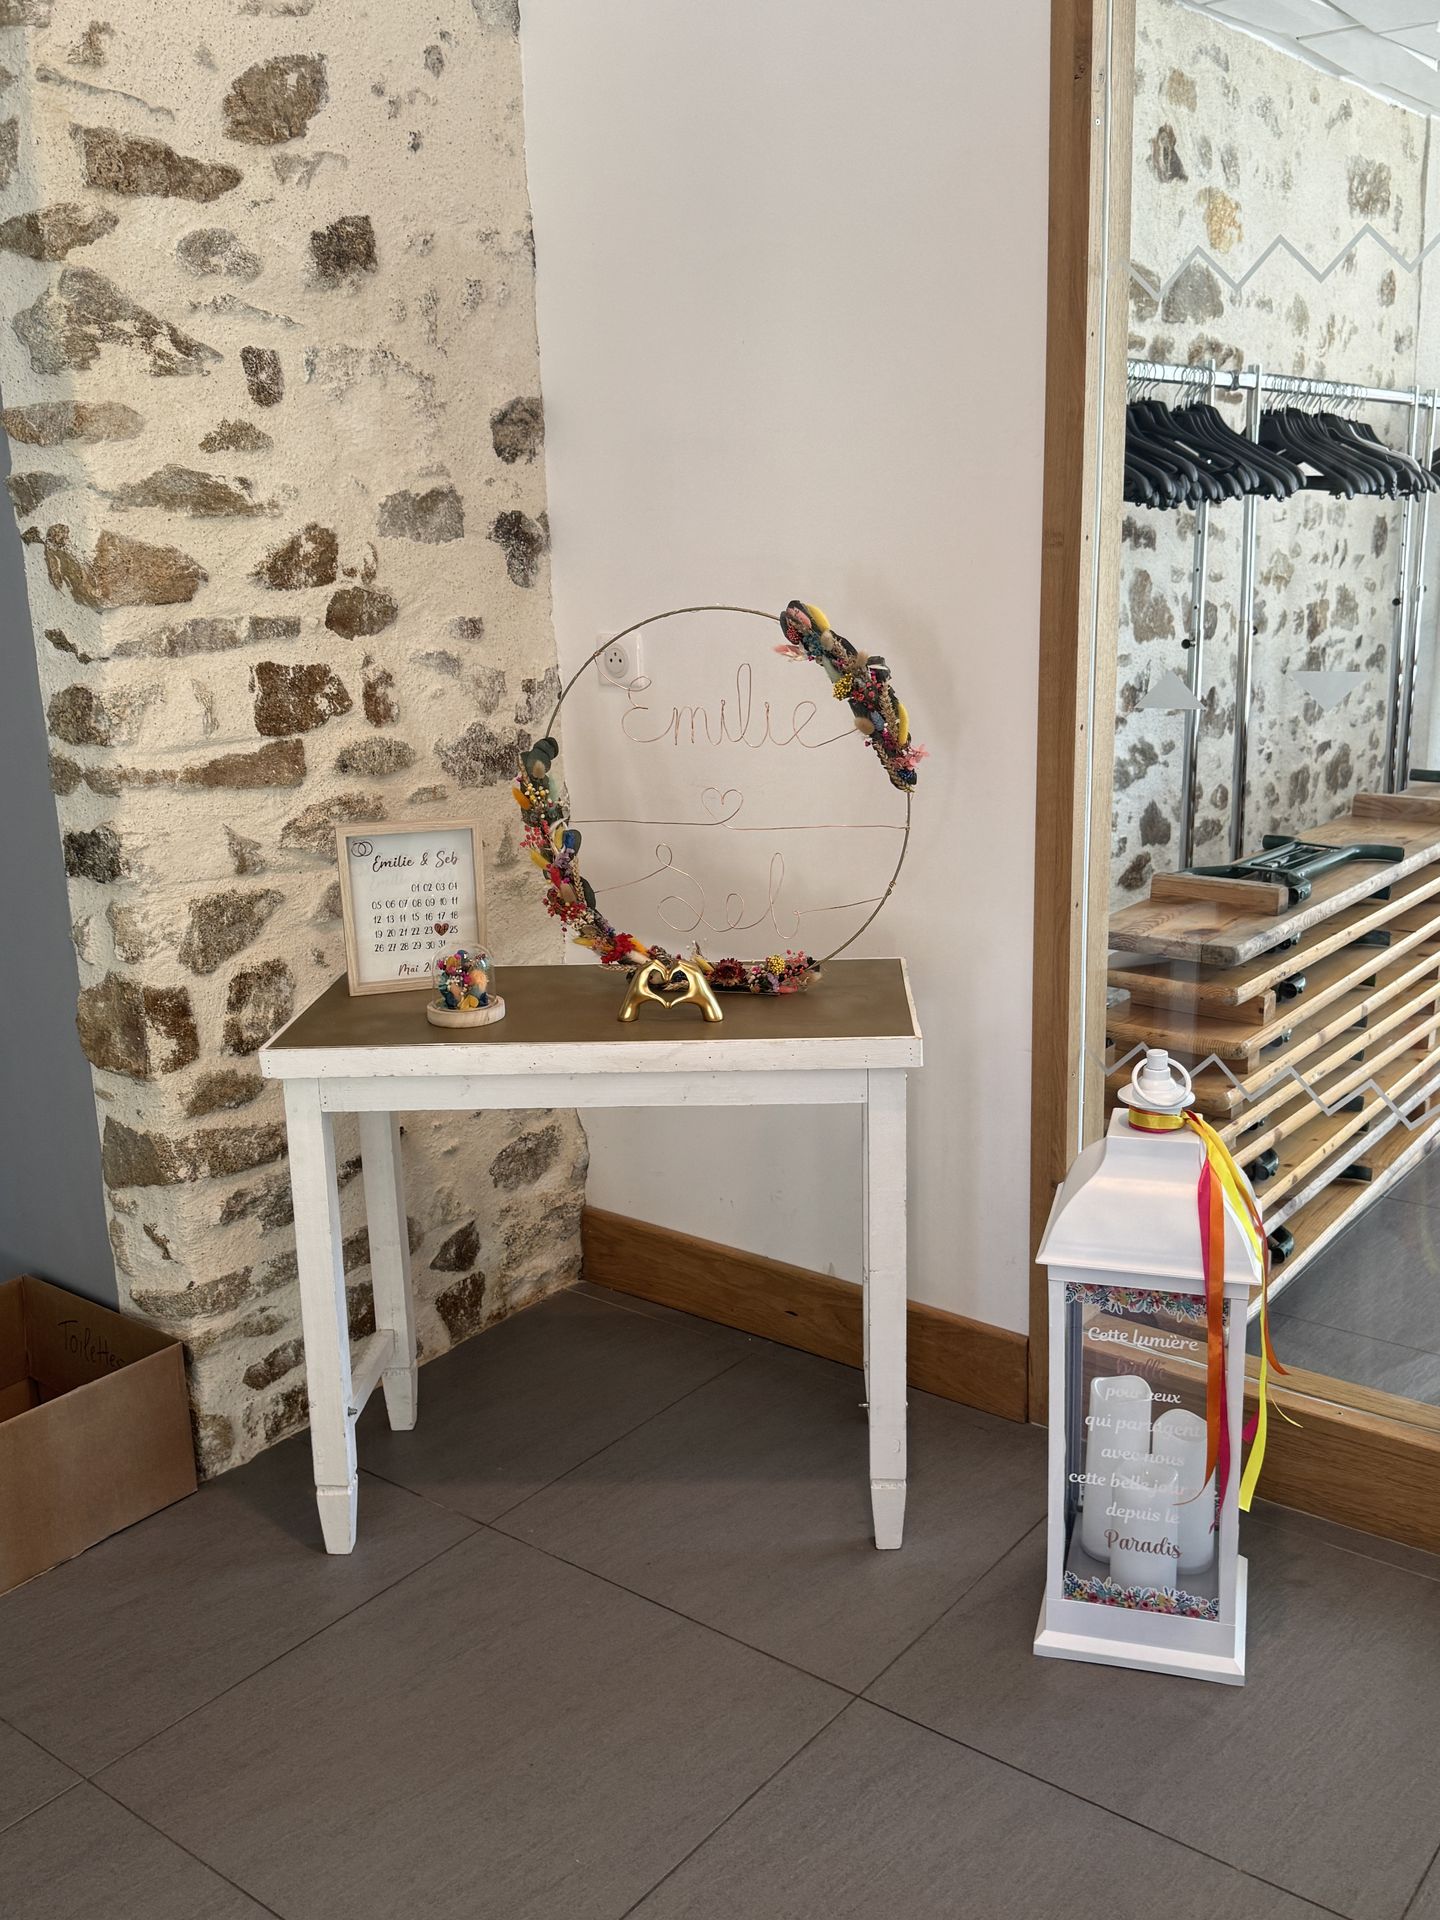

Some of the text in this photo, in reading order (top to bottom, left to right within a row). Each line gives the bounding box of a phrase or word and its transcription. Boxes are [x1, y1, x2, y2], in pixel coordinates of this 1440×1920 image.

[621, 662, 818, 748] Emilie
[372, 850, 459, 873] Emilie & Seb
[411, 883, 420, 892] 01
[423, 883, 433, 892] 02
[435, 882, 446, 891] 03
[655, 842, 802, 940] Seb
[371, 896, 458, 909] 05 06 07 08 09 10 11
[373, 915, 382, 924] 12
[386, 915, 395, 923] 13
[412, 913, 420, 922] 15
[425, 912, 434, 921] 16
[438, 911, 446, 920] 17
[450, 910, 459, 919] 18
[375, 930, 383, 938] 19
[386, 929, 397, 938] 20
[399, 928, 408, 936] 21
[411, 927, 420, 936] 22
[424, 926, 434, 934] 23
[449, 925, 459, 934] 25
[374, 940, 446, 952] 26 27 28 29 30 31
[398, 963, 419, 976] Mai
[1088, 1326, 1200, 1352] Cette lumière
[1084, 1414, 1112, 1432] qui
[1068, 1472, 1106, 1488] cette
[1105, 1501, 1181, 1525] depuis le
[1103, 1528, 1184, 1560] Paradis
